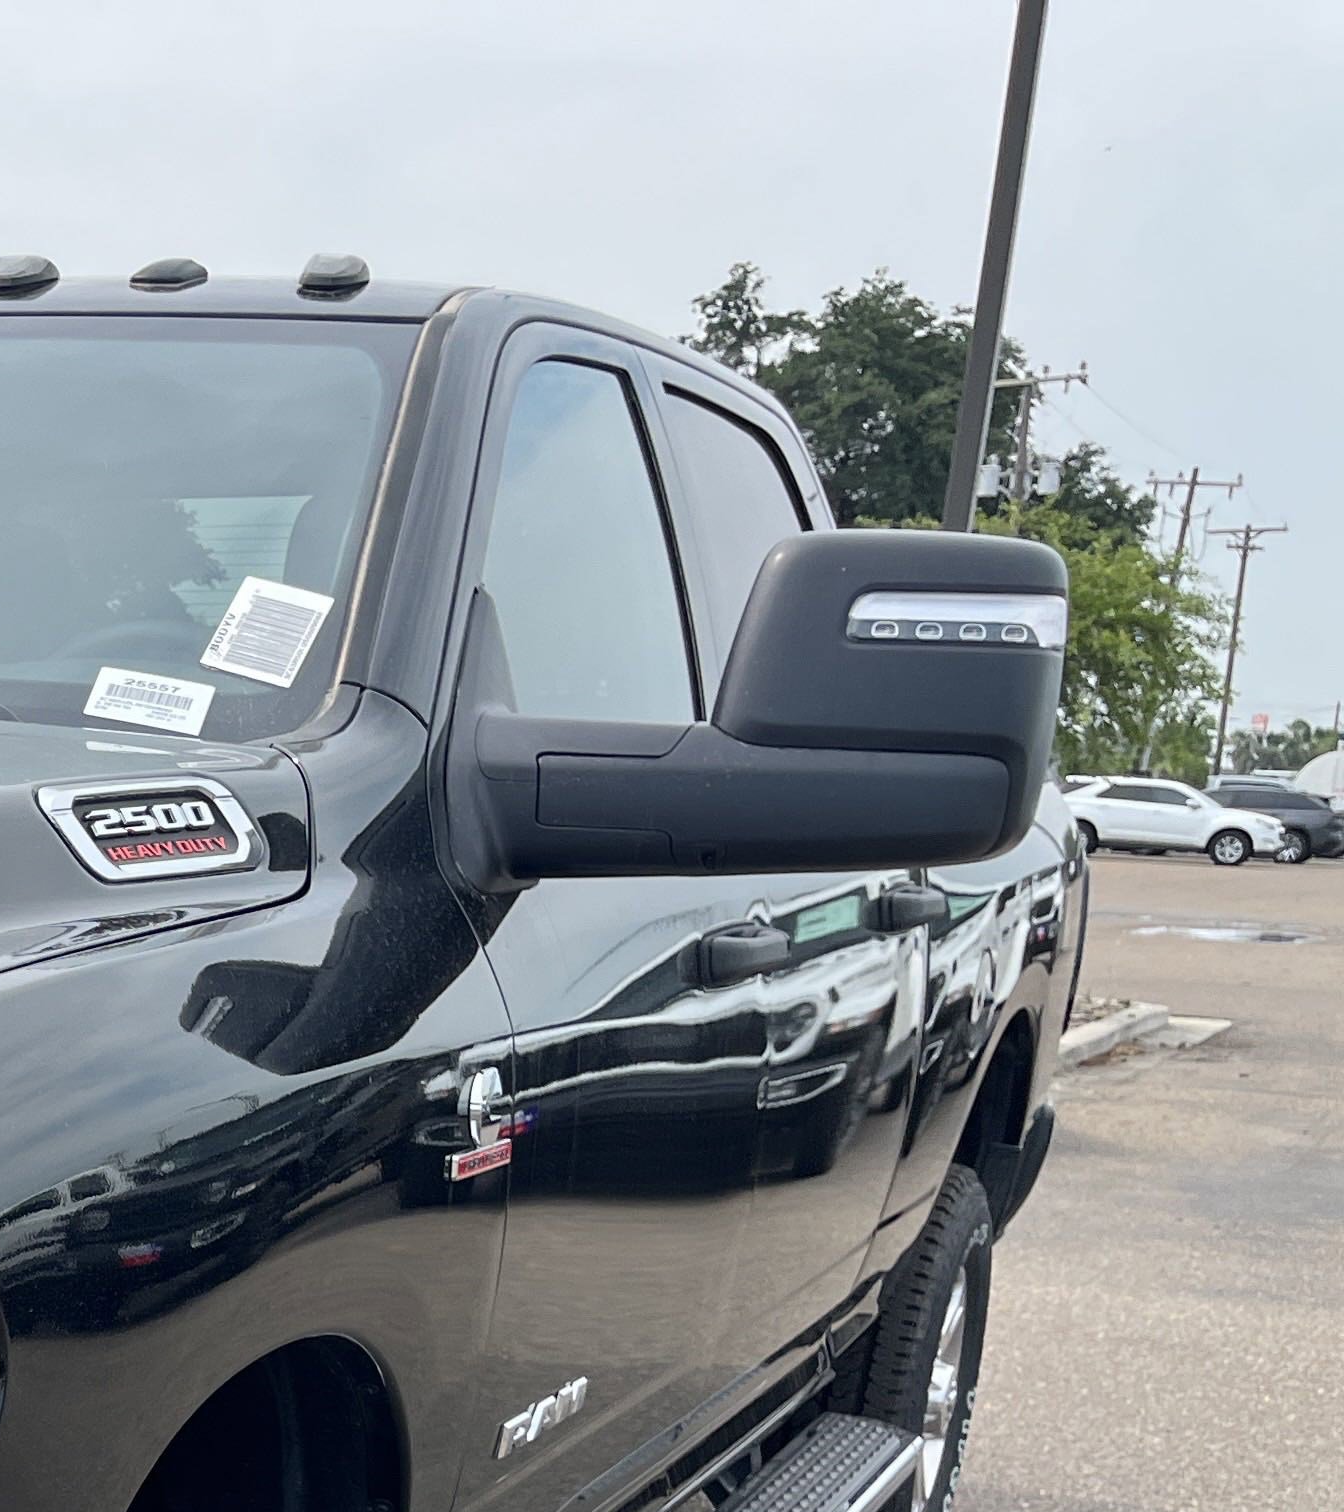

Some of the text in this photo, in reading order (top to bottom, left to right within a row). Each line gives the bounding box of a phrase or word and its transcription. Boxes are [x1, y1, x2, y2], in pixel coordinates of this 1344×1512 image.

[83, 800, 216, 839] 2500
[108, 836, 228, 861] HEAVY DUTY
